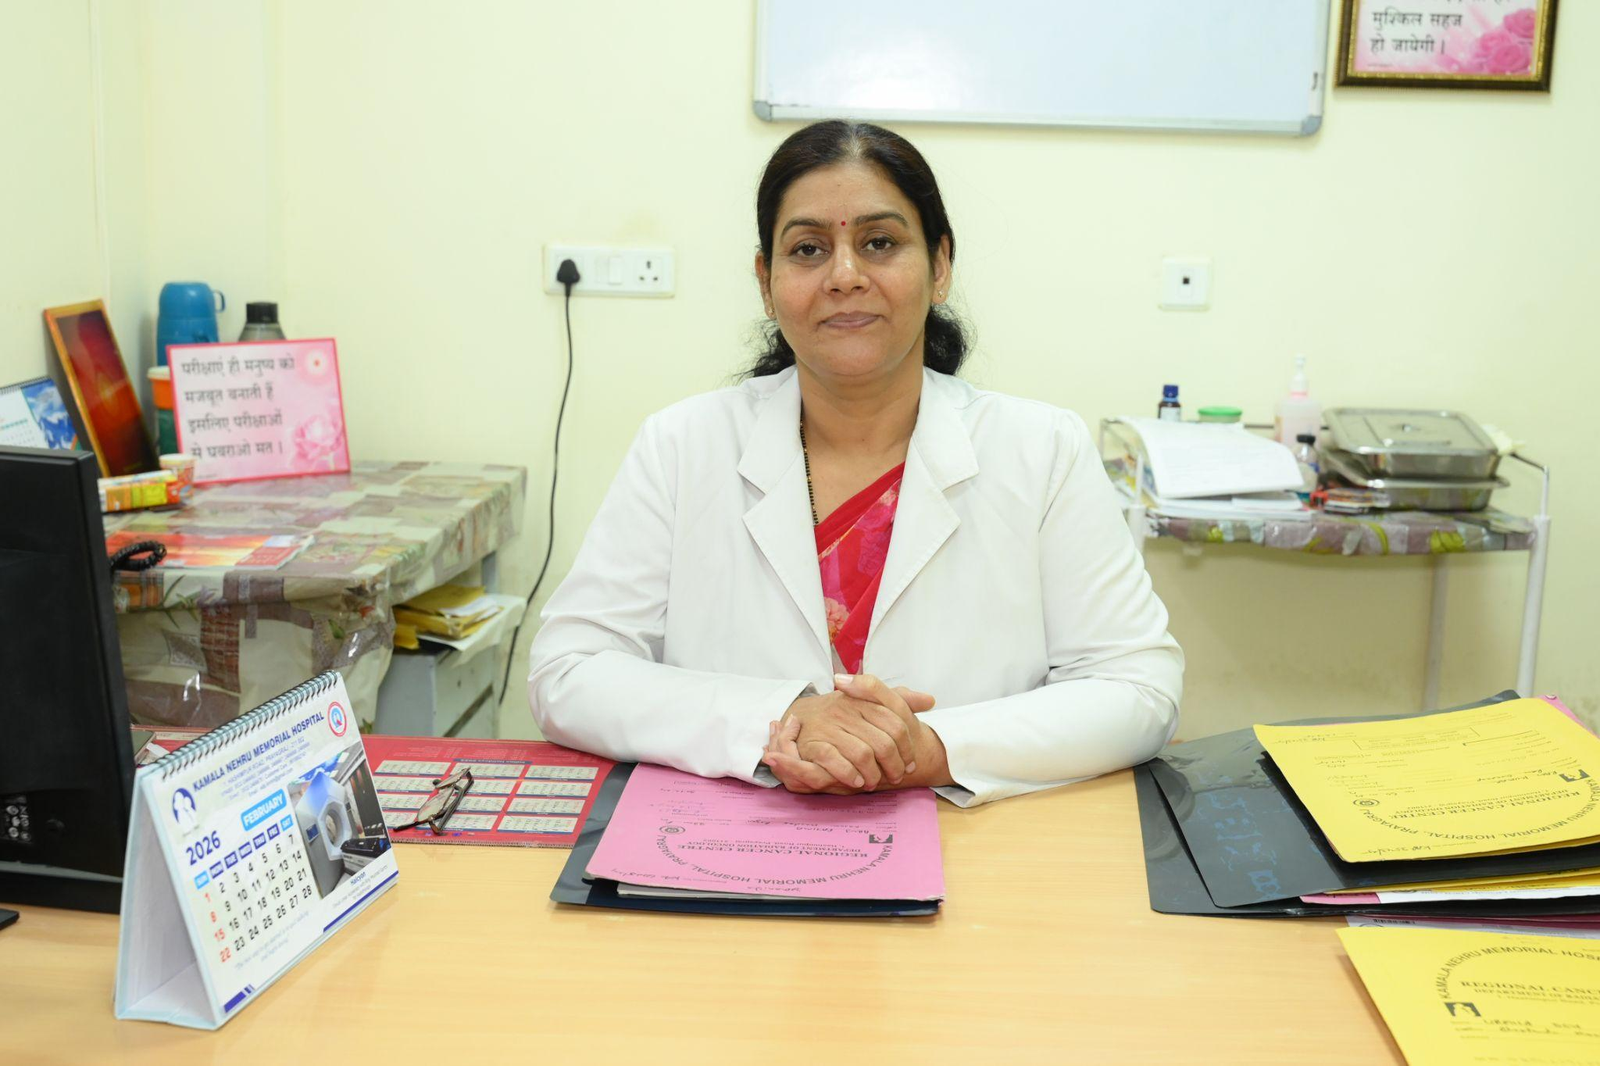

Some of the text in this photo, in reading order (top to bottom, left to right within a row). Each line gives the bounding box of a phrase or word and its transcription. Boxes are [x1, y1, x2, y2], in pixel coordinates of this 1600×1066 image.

[1372, 7, 1462, 30] मुश्किल सहज
[1370, 34, 1384, 55] हो
[1392, 34, 1435, 53] जायेगी
[228, 355, 240, 375] ही
[244, 358, 275, 377] मनुष्य
[279, 354, 295, 370] को
[256, 442, 273, 454] मत
[192, 767, 225, 792] KAMALA
[226, 752, 252, 773] NEHRU
[253, 730, 291, 758] MEMORIAL
[291, 712, 324, 736] HOSPITAL
[244, 793, 284, 826] FEBRUARY
[1450, 804, 1504, 814] CANCER
[1511, 791, 1580, 806] REGIONAL
[1566, 803, 1596, 821] NEHRU
[1498, 820, 1568, 838] MEMORIAL
[186, 830, 220, 866] 2026
[678, 844, 732, 852] CENTRE
[868, 845, 893, 868] KAMALA
[204, 834, 294, 902] 1 2 3 4 5 6 7
[830, 866, 870, 881] NEHRU
[224, 900, 231, 912] 9
[238, 888, 248, 902] 10
[252, 879, 262, 892] 11
[266, 869, 276, 881] 12
[280, 860, 288, 872] 13
[292, 850, 302, 862] 14
[214, 928, 225, 942] 15
[244, 907, 252, 920] 17
[272, 886, 280, 900] 19
[284, 877, 294, 890] 20
[297, 868, 306, 882] 21
[220, 885, 312, 962] 22 23 24 25 26 27 28
[1434, 968, 1451, 999] KAMALA
[1445, 950, 1482, 968] NEHRU
[1481, 946, 1558, 955] MEMORIAL
[1460, 981, 1546, 991] REGIONAL
